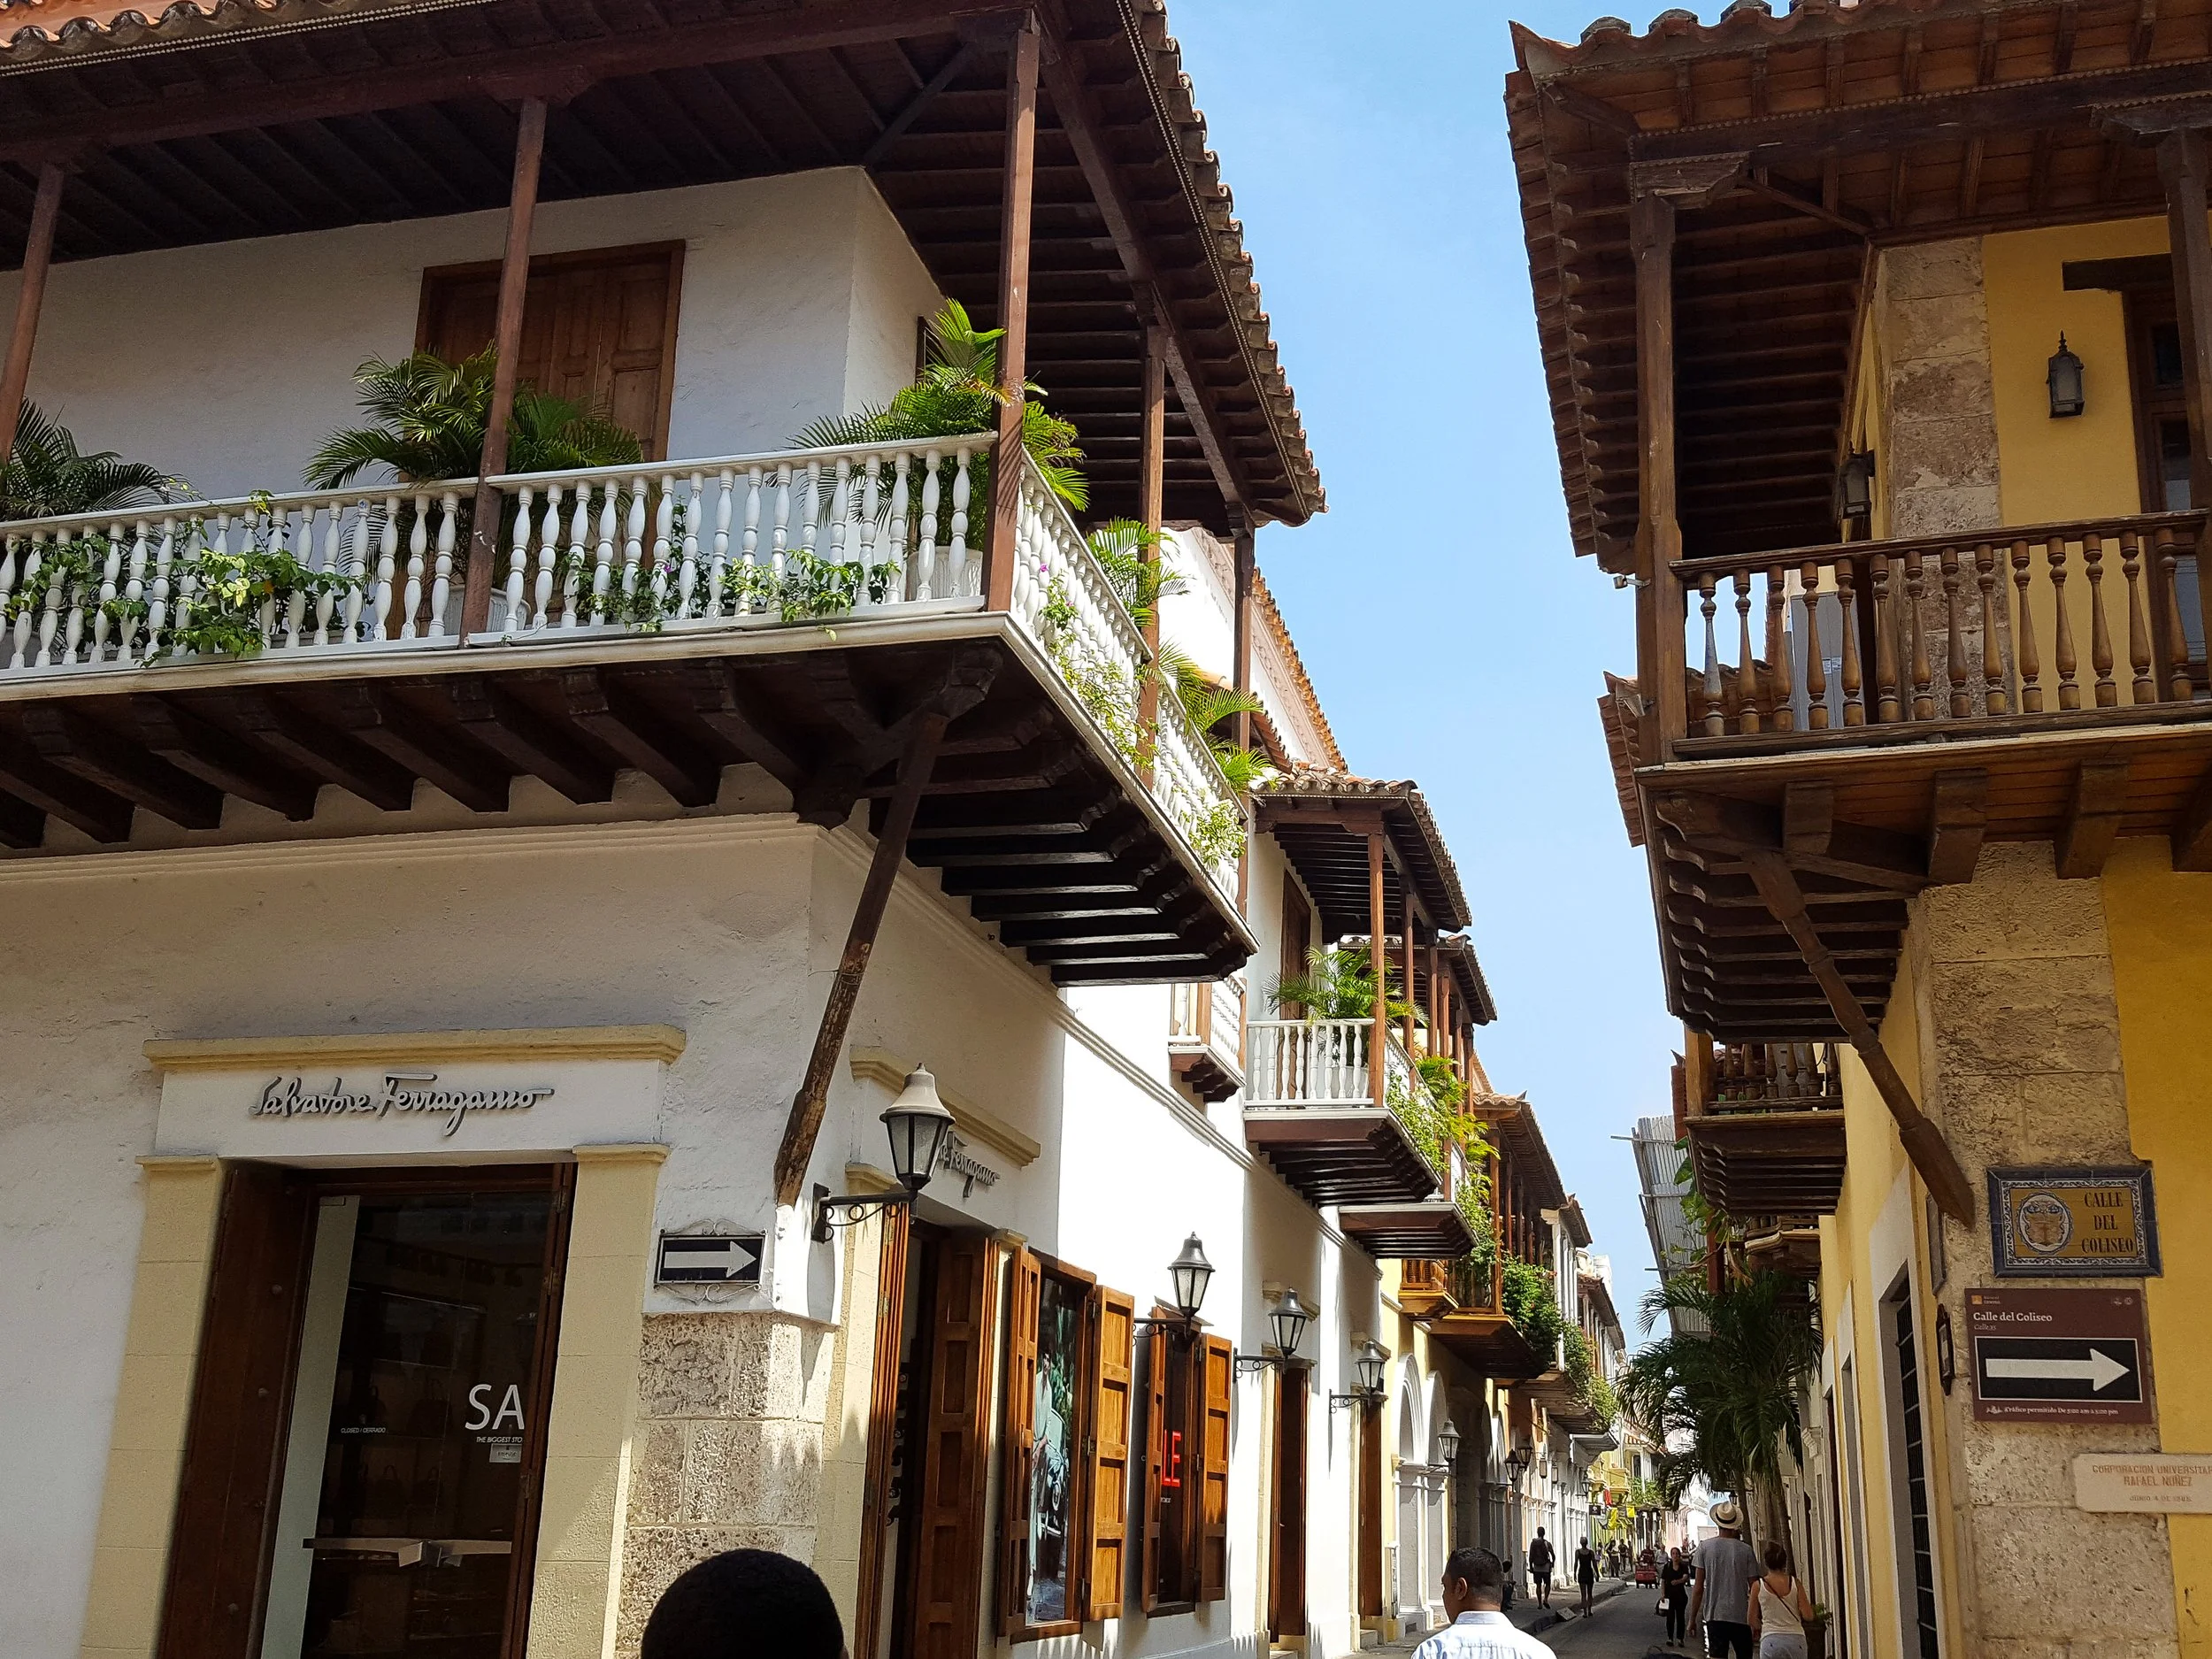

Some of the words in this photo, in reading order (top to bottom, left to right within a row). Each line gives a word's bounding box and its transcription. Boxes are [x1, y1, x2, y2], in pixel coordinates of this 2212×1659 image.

[251, 1076, 374, 1117] Salvatore
[376, 1072, 555, 1137] Ferragamo
[2084, 1191, 2124, 1208] CALLE
[2093, 1214, 2118, 1230] DEL
[2081, 1237, 2133, 1254] COLISEO
[1973, 1311, 1998, 1322] Calle
[2000, 1311, 2015, 1322] del
[2016, 1311, 2053, 1323] Coliseo
[2124, 1475, 2159, 1486] RAFAEL
